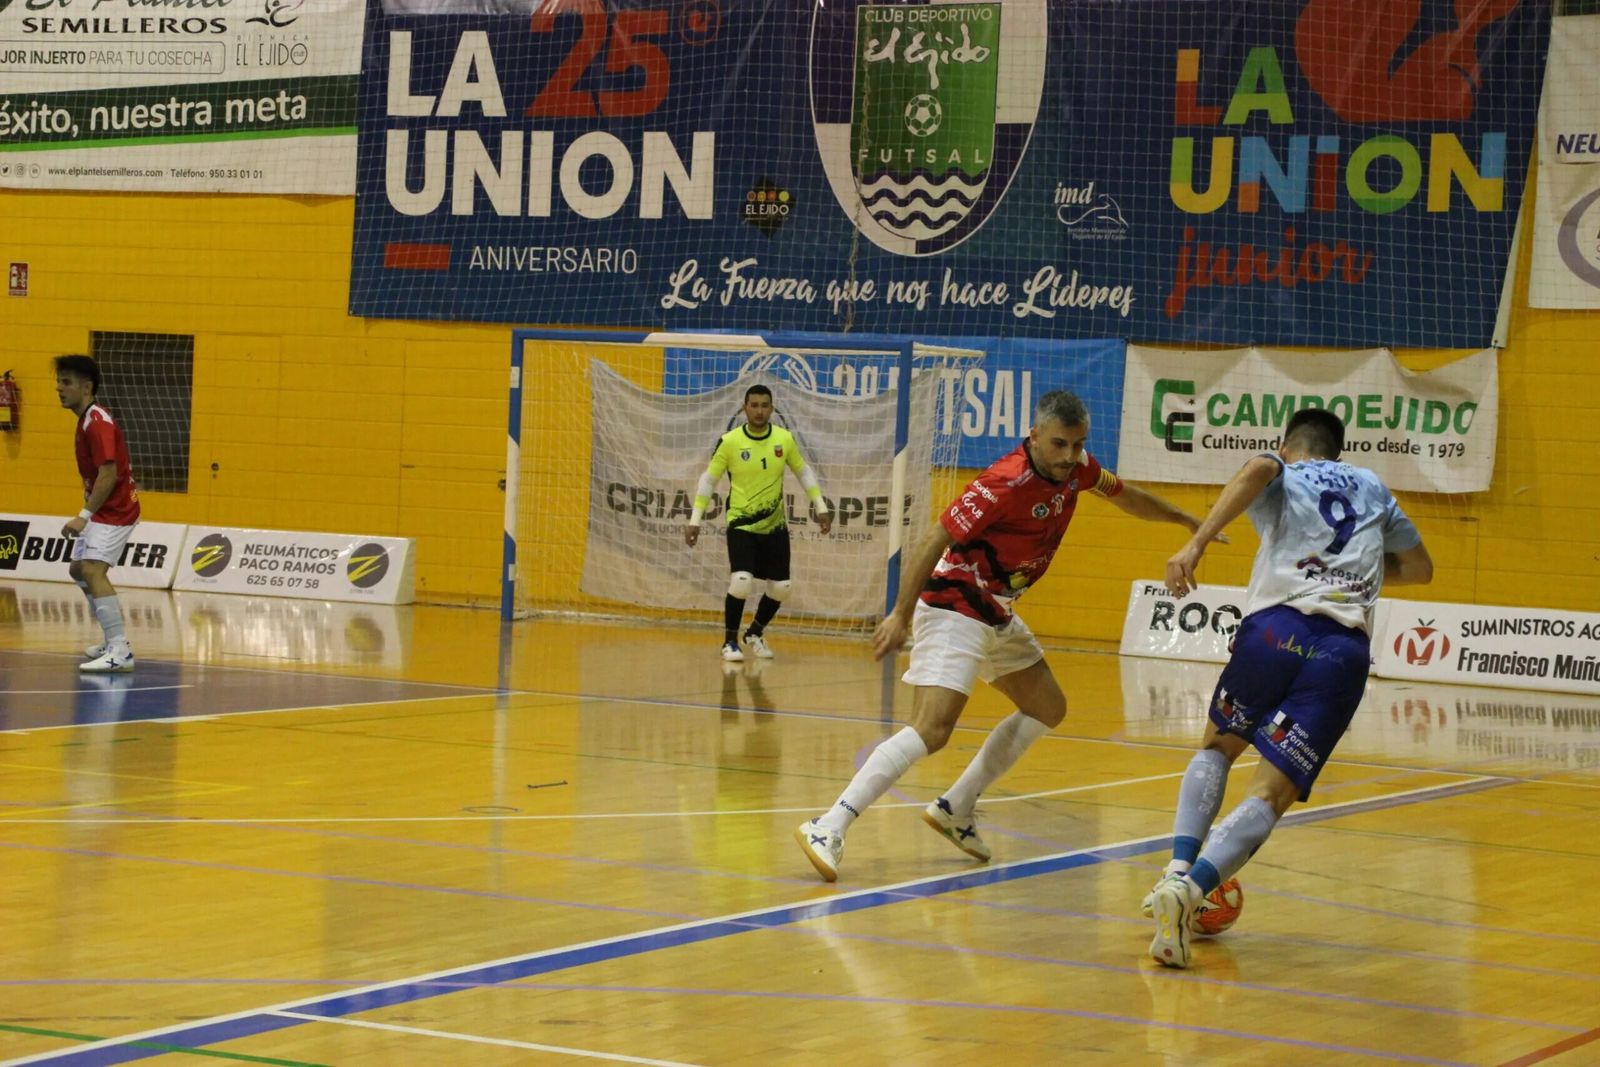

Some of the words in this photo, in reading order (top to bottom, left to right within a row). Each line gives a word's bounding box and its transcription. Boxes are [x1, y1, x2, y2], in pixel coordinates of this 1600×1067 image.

[22, 17, 228, 34] SEMILLEROS
[865, 9, 904, 23] CLUB
[908, 8, 993, 22] DEPORTIVO
[30, 50, 86, 64] INJERTO
[88, 51, 123, 64] PARA
[127, 51, 144, 65] TU
[148, 50, 212, 66] COSECHA
[236, 43, 249, 65] EL
[259, 43, 308, 65] EJIDO
[387, 30, 507, 117] LA
[1174, 48, 1294, 125] LA
[0, 100, 79, 138] éxito,
[90, 96, 212, 131] nuestra
[225, 90, 307, 124] meta
[858, 148, 986, 165] FUTSAL
[209, 169, 225, 178] 950
[227, 169, 237, 178] 33
[240, 170, 250, 178] 01
[253, 170, 263, 178] 01
[385, 129, 715, 220] UNION
[1170, 132, 1506, 215] UNION
[1054, 182, 1094, 204] imd
[760, 204, 789, 215] EJIDO
[469, 246, 638, 274] ANIVERSARIO
[1164, 226, 1373, 318] junior
[661, 259, 713, 309] La
[720, 256, 817, 306] Fuerza
[827, 281, 876, 314] que
[887, 279, 931, 311] nos
[942, 267, 1009, 305] hace
[1202, 434, 1282, 451] Cultivand
[1377, 437, 1421, 455] desde
[1428, 442, 1466, 459] 1979
[761, 457, 767, 470] 1
[1319, 490, 1357, 555] 9
[243, 544, 339, 561] NEUMÁTICOS
[239, 558, 280, 572] PACO
[283, 562, 336, 575] RAMOS
[246, 575, 267, 585] 625
[270, 576, 284, 587] 65
[287, 577, 302, 588] 07
[304, 578, 319, 589] 58
[1461, 619, 1575, 638] SUMINISTROS
[1457, 647, 1549, 677] Francisco
[1279, 740, 1287, 749] &
